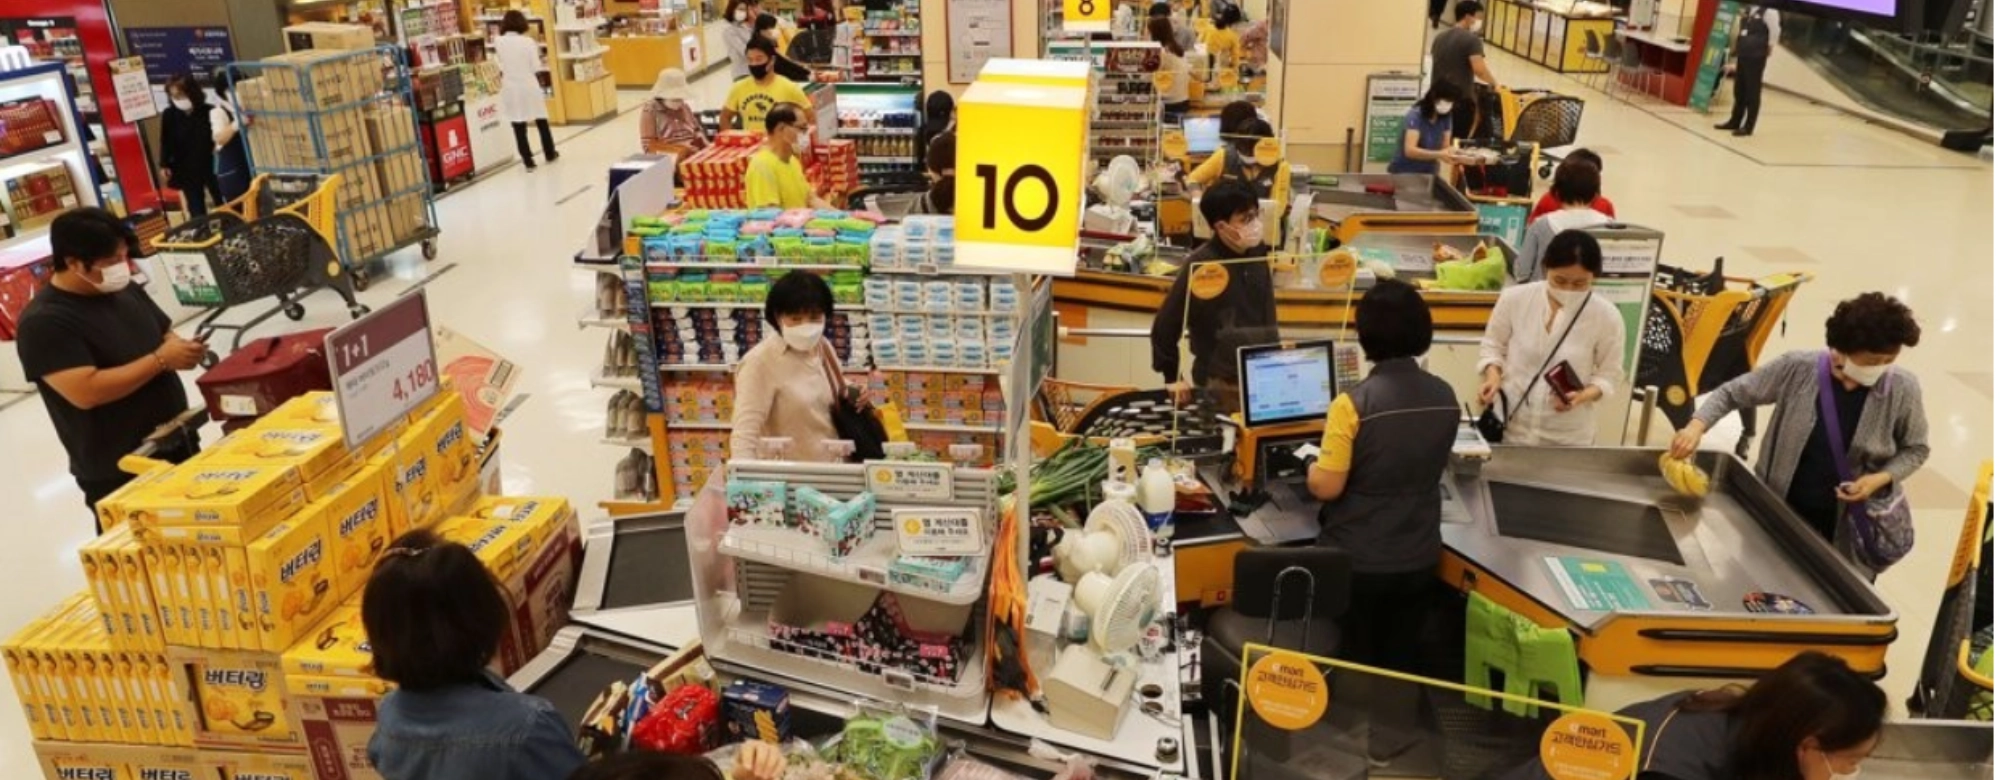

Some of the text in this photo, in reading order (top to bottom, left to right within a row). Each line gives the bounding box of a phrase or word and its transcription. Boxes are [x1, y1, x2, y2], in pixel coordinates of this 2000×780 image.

[1078, 0, 1095, 16] 8
[476, 103, 498, 119] GNC
[443, 146, 468, 164] GNC
[975, 163, 1059, 232] 10
[343, 334, 368, 367] 1+1
[392, 358, 434, 401] 4,180
[339, 497, 379, 537] 버터링
[281, 538, 321, 583] 버터링
[205, 669, 266, 689] 버터링
[1257, 670, 1318, 693] 고객안심가드
[1551, 731, 1621, 755] 고객안심가드
